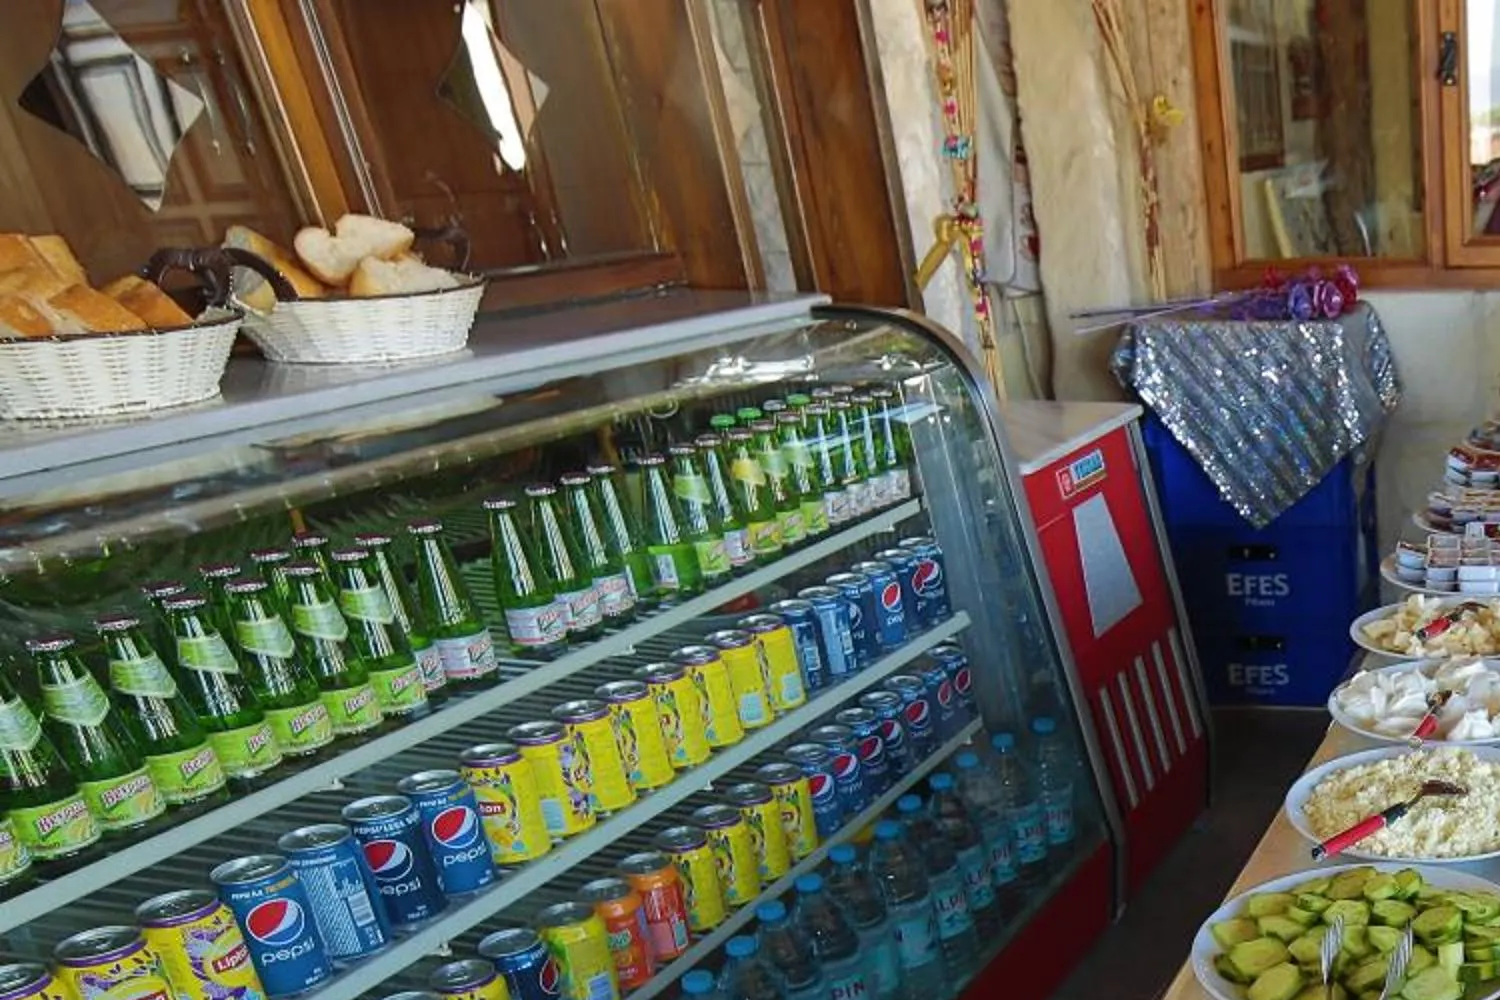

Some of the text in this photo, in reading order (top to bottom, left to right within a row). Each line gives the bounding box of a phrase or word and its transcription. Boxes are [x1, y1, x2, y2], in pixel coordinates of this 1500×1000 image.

[1226, 573, 1290, 596] EFES
[1228, 663, 1290, 686] EFES
[442, 841, 487, 867] pepsi
[216, 943, 249, 971] Lipto
[260, 936, 316, 967] pepsi
